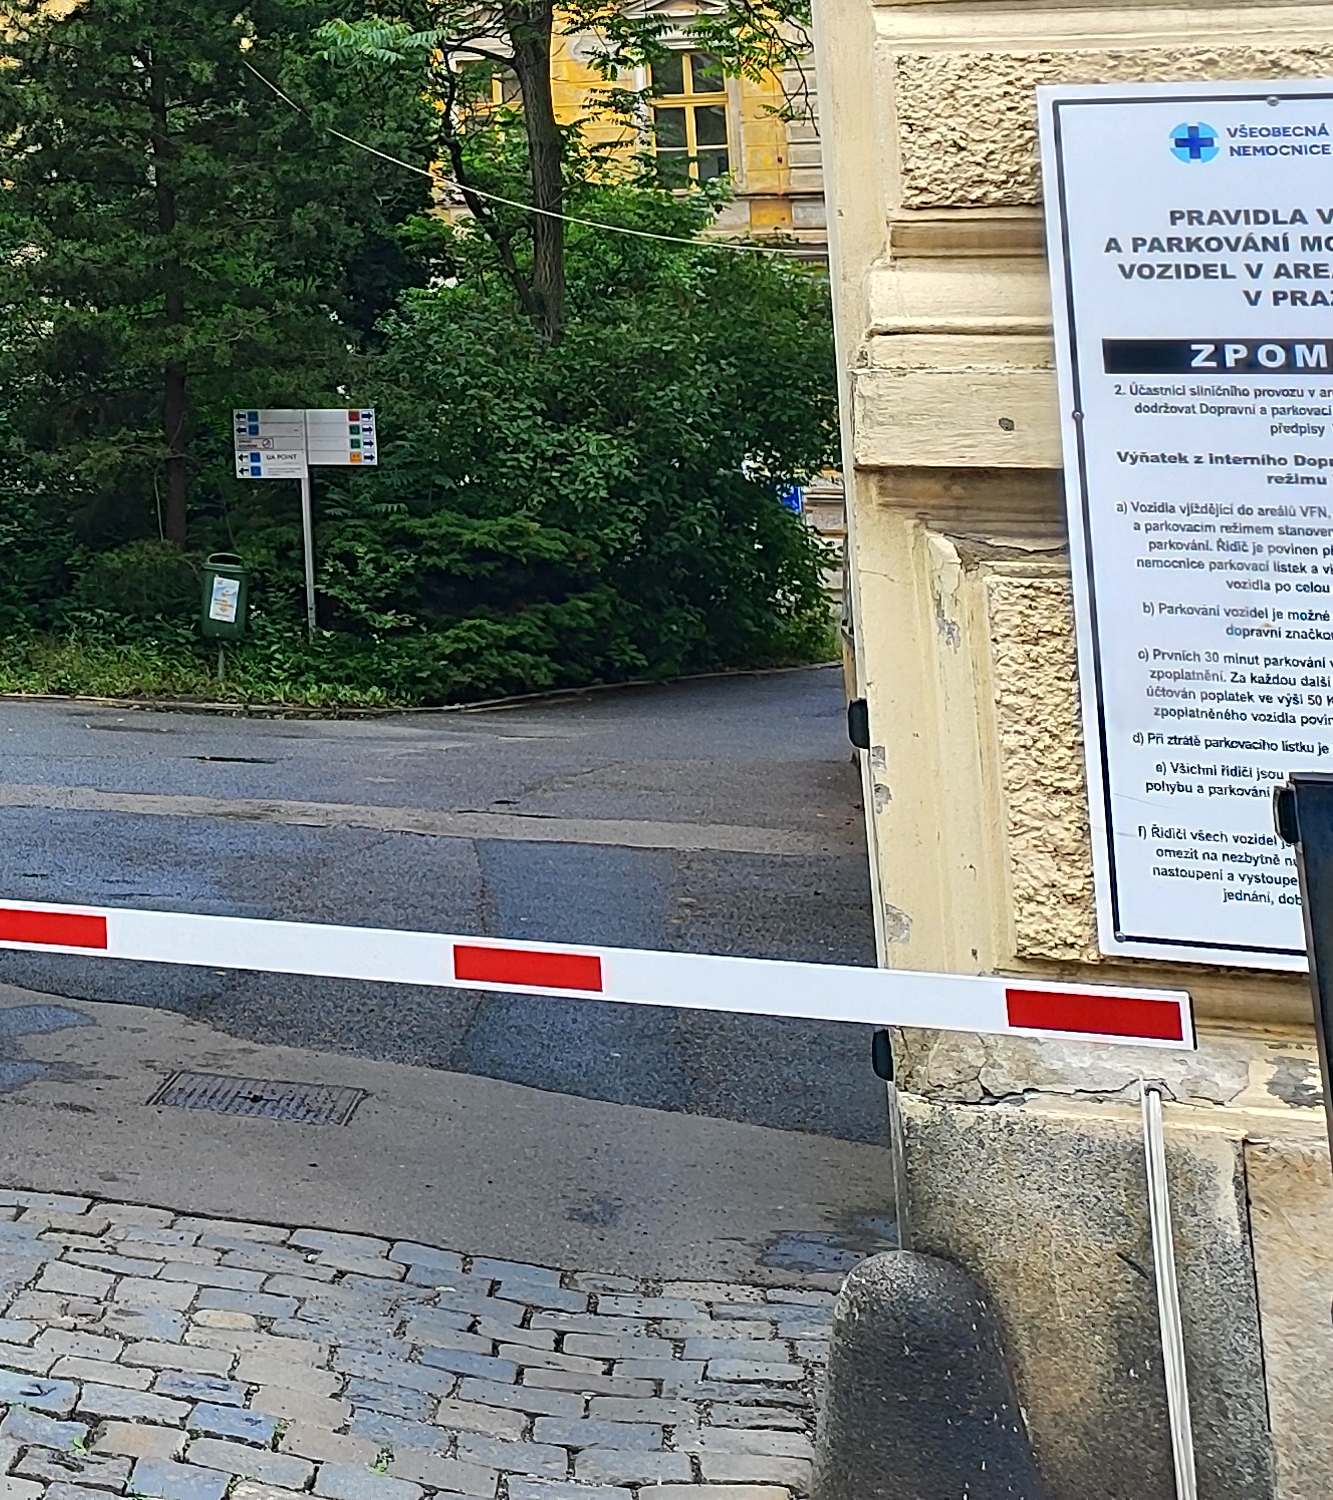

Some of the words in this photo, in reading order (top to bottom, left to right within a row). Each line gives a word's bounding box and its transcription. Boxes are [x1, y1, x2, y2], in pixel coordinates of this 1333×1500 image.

[1226, 123, 1330, 138] VŠEOBECNÁ
[1229, 144, 1332, 157] NEMOCNICE
[1169, 209, 1309, 226] PRAVIDLA
[1104, 237, 1123, 253] A
[1132, 232, 1289, 253] PARKOVÁNÍ
[1118, 263, 1237, 279] VOZIDEL
[1244, 263, 1264, 279] V
[1242, 290, 1262, 307] V
[1254, 387, 1305, 400] provozu
[1134, 402, 1197, 415] dodržovat
[1259, 406, 1267, 415] a
[1117, 451, 1189, 466] Výňatek
[1194, 455, 1204, 464] z
[1131, 501, 1176, 514] Vozidla
[1237, 504, 1254, 516] do
[1133, 522, 1141, 531] a
[1220, 522, 1274, 536] režimem
[1268, 544, 1318, 557] povinen
[1136, 557, 1205, 570] nemocnice
[1311, 564, 1318, 574] a
[1225, 578, 1271, 591] vozidla
[1275, 582, 1291, 594] po
[1142, 601, 1155, 616] b)
[1223, 606, 1269, 620] vozidel
[1271, 608, 1284, 622] je
[1287, 609, 1331, 622] možné
[1204, 651, 1219, 663] 30
[1223, 653, 1260, 666] minut
[1230, 672, 1246, 684] Za
[1250, 672, 1296, 686] každou
[1300, 675, 1332, 688] další
[1200, 690, 1255, 704] poplatek
[1258, 694, 1273, 704] ve
[1307, 694, 1322, 706] 50
[1153, 706, 1247, 722] zpoplatněného
[1251, 711, 1296, 724] vozidla
[1132, 732, 1144, 746] d)
[1317, 742, 1329, 756] je
[1256, 767, 1284, 781] jsou
[1146, 780, 1193, 795] pohybu
[1196, 785, 1204, 794] a
[1189, 829, 1229, 843] všech
[1232, 832, 1277, 846] vozidel
[1156, 847, 1199, 861] omezit
[1202, 850, 1218, 861] na
[1222, 852, 1281, 867] nezbytně
[1152, 866, 1224, 881] nastoupení
[1227, 871, 1235, 881] a
